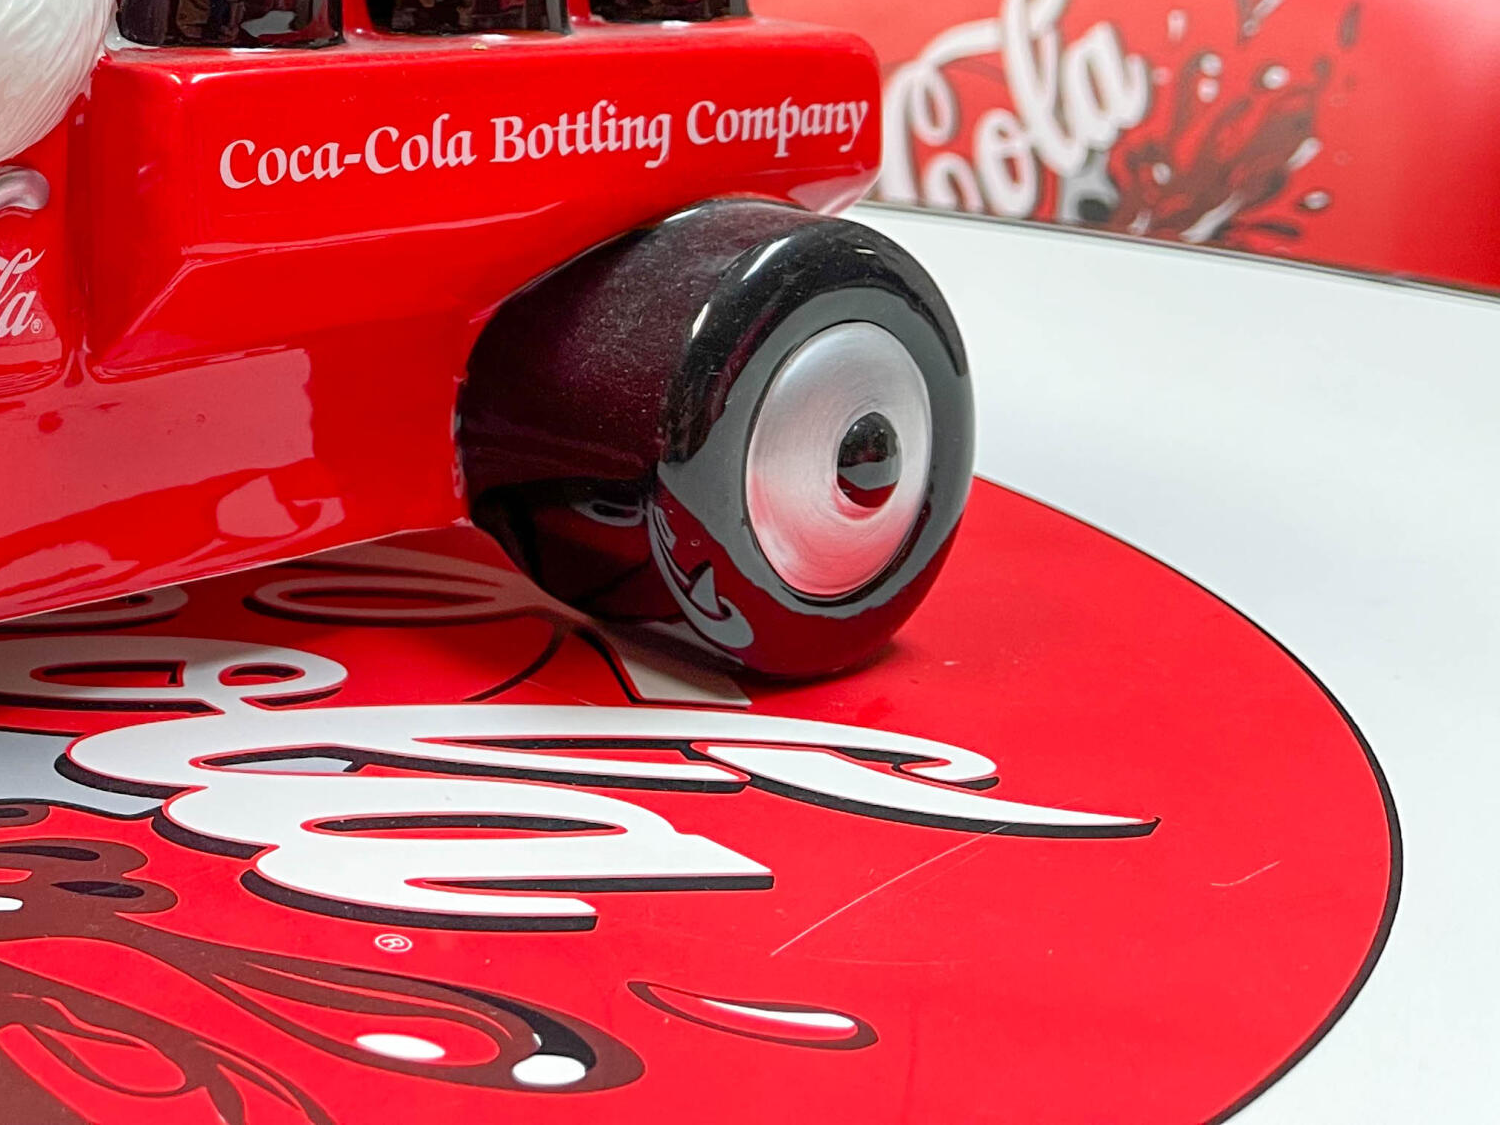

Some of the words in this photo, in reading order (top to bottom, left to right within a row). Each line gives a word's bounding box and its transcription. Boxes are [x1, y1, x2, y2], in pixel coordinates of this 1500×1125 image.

[219, 113, 477, 189] Coca-Cola
[490, 99, 671, 169] Bottling
[686, 99, 869, 157] Company
